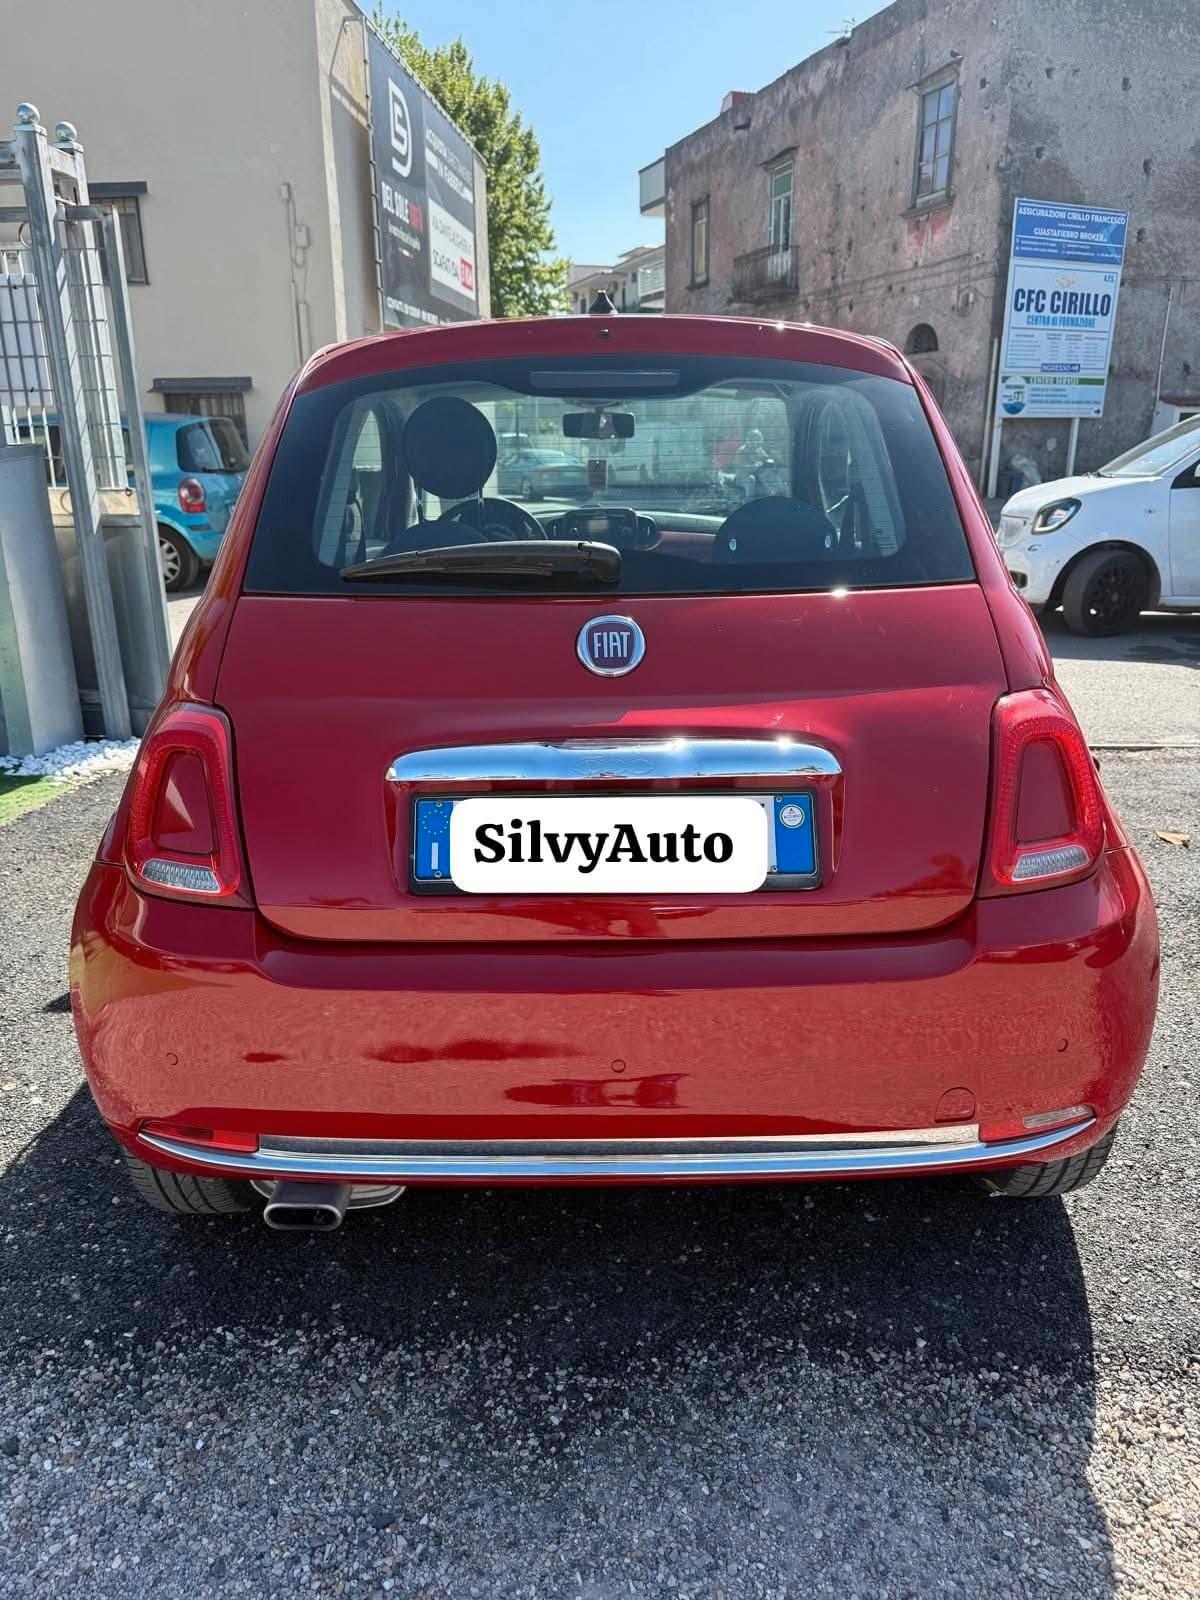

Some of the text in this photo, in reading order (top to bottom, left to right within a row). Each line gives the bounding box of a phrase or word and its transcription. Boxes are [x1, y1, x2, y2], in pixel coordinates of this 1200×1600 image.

[1018, 207, 1126, 225] ASSICURAZIONI CIRILLO FRANCESCO
[1013, 288, 1111, 317] CFC CIRILLO
[1026, 315, 1050, 326] CENTRO
[1059, 317, 1096, 328] FORMAZIONE
[593, 631, 631, 659] FIAT
